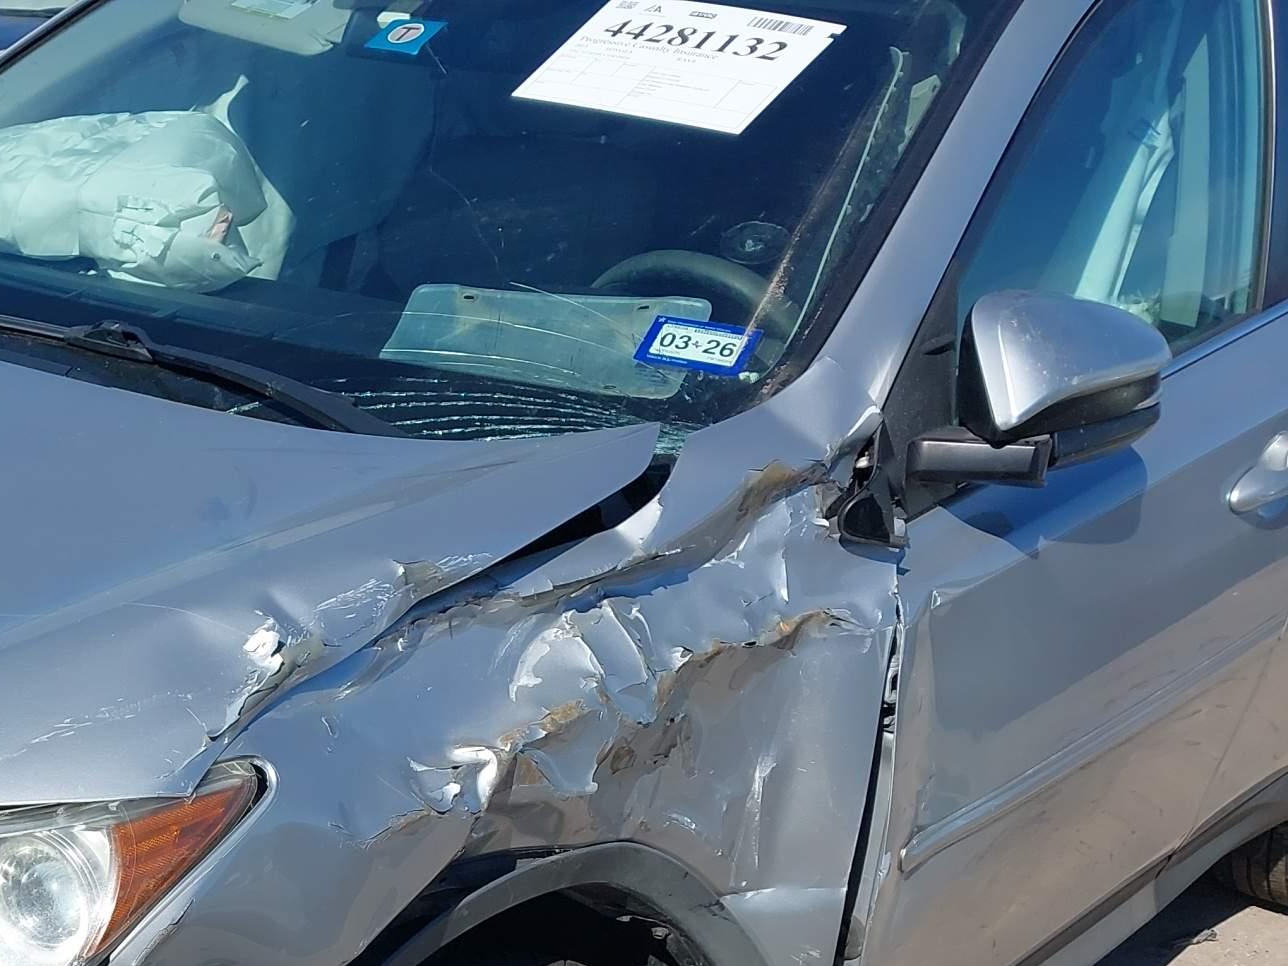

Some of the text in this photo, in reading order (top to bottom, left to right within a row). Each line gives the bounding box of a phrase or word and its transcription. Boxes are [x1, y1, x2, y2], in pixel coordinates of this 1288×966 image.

[604, 19, 789, 61] 44281132
[659, 332, 692, 350] 03
[702, 339, 737, 358] 26
